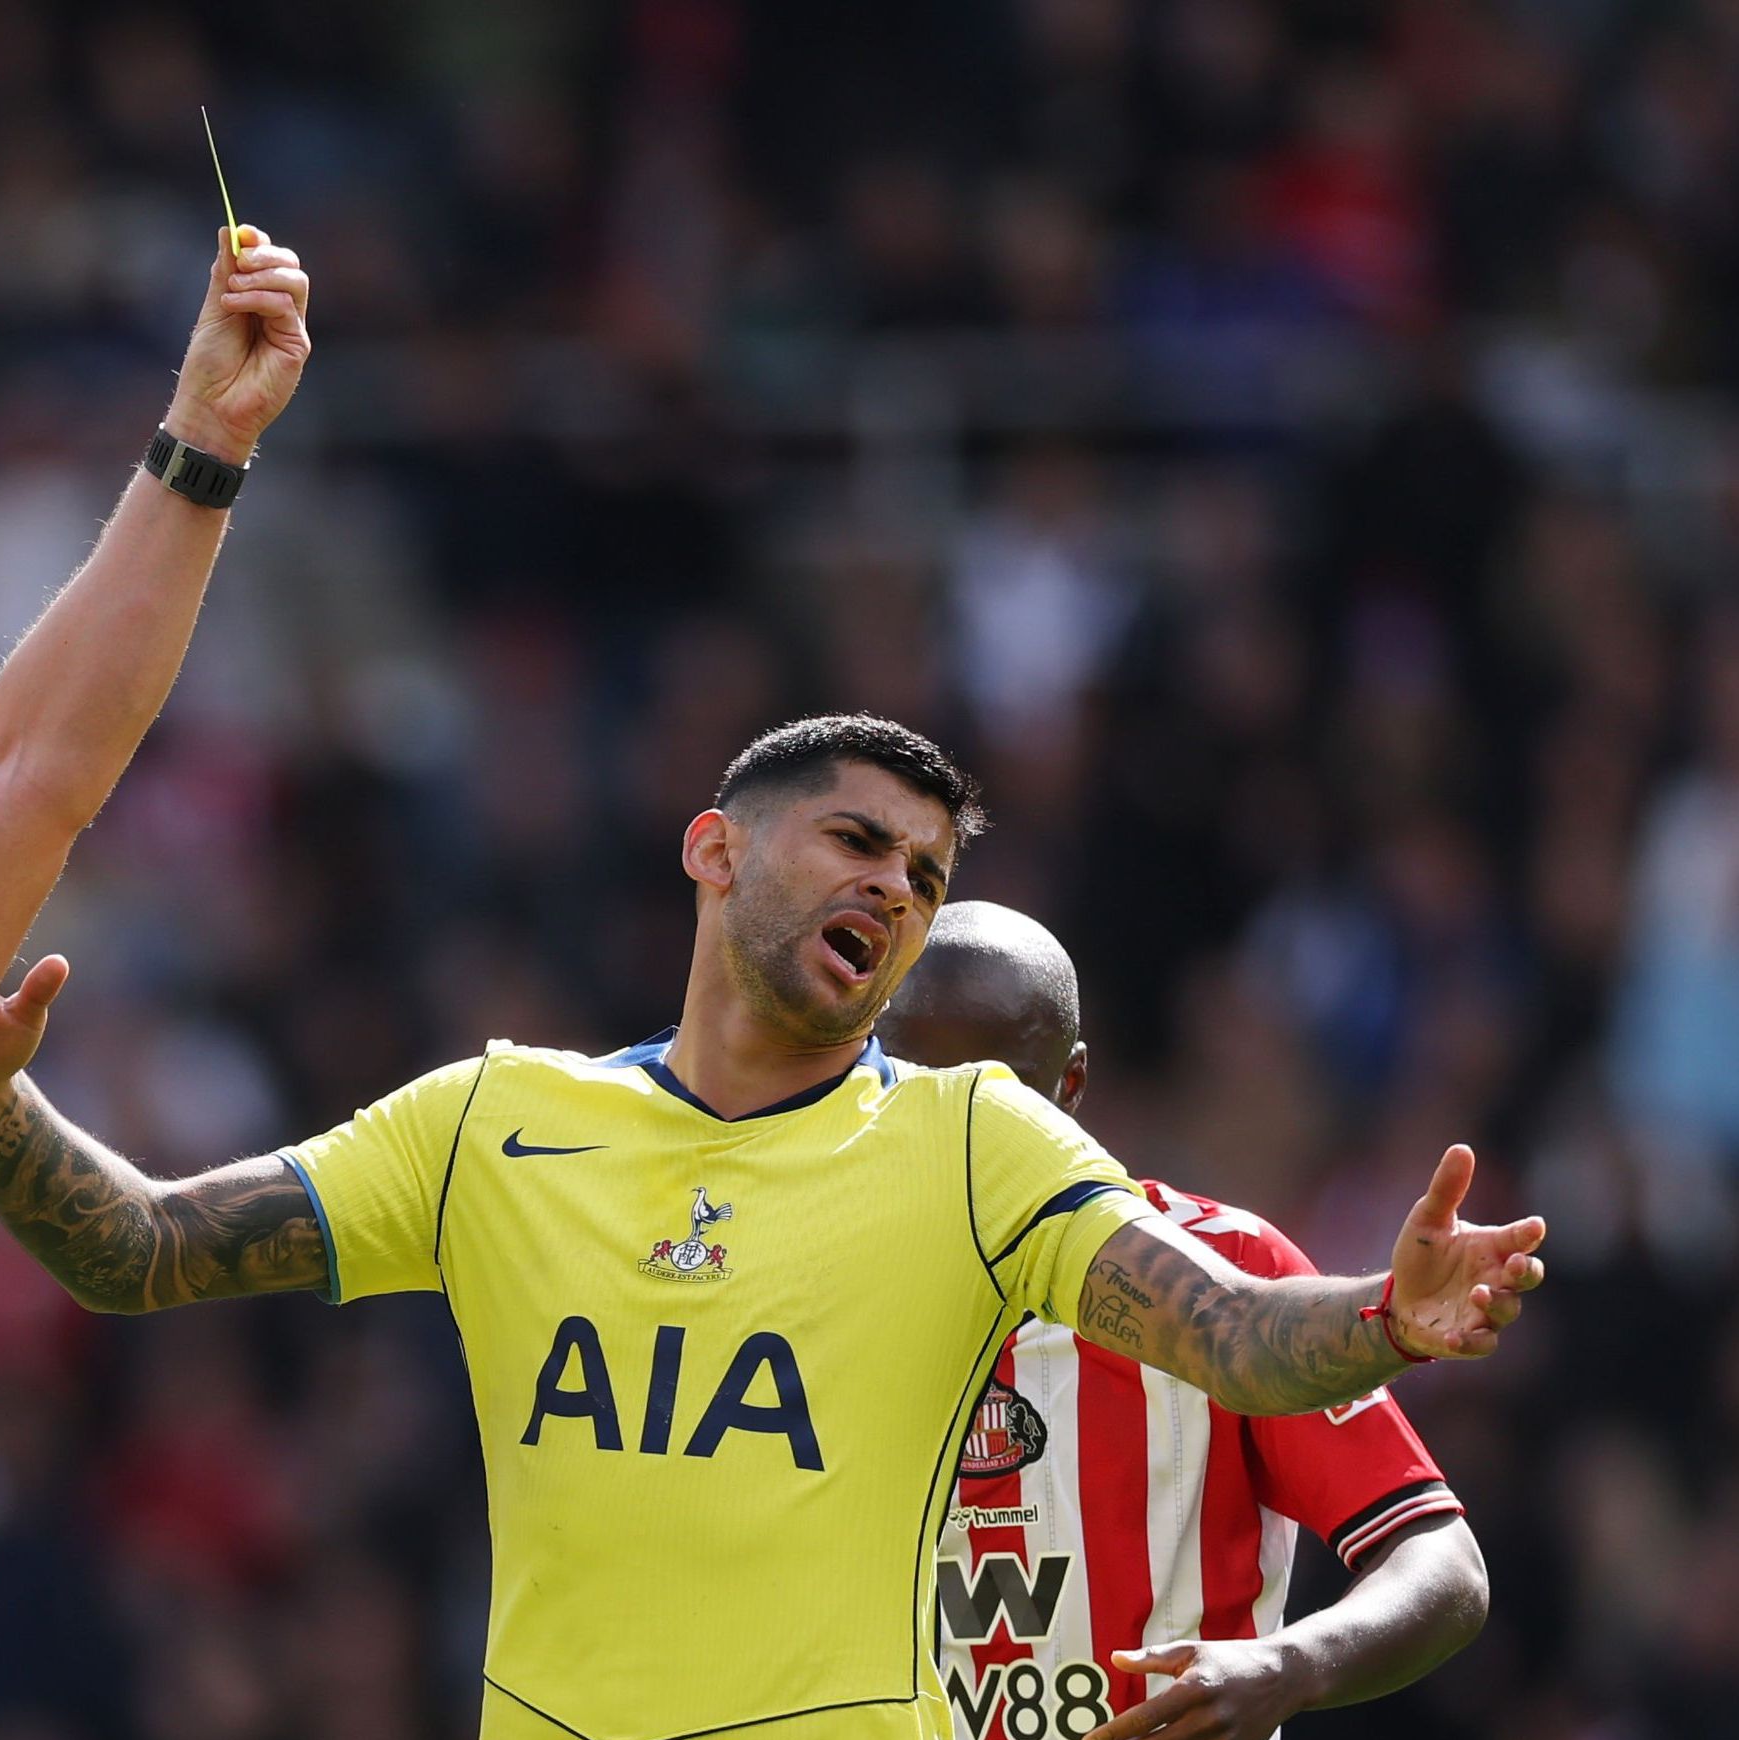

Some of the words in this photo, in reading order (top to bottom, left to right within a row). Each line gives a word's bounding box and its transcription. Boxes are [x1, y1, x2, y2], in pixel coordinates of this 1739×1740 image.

[1084, 1282, 1144, 1349] Victor
[519, 1315, 825, 1472] AIA
[973, 1504, 1039, 1526] hummel
